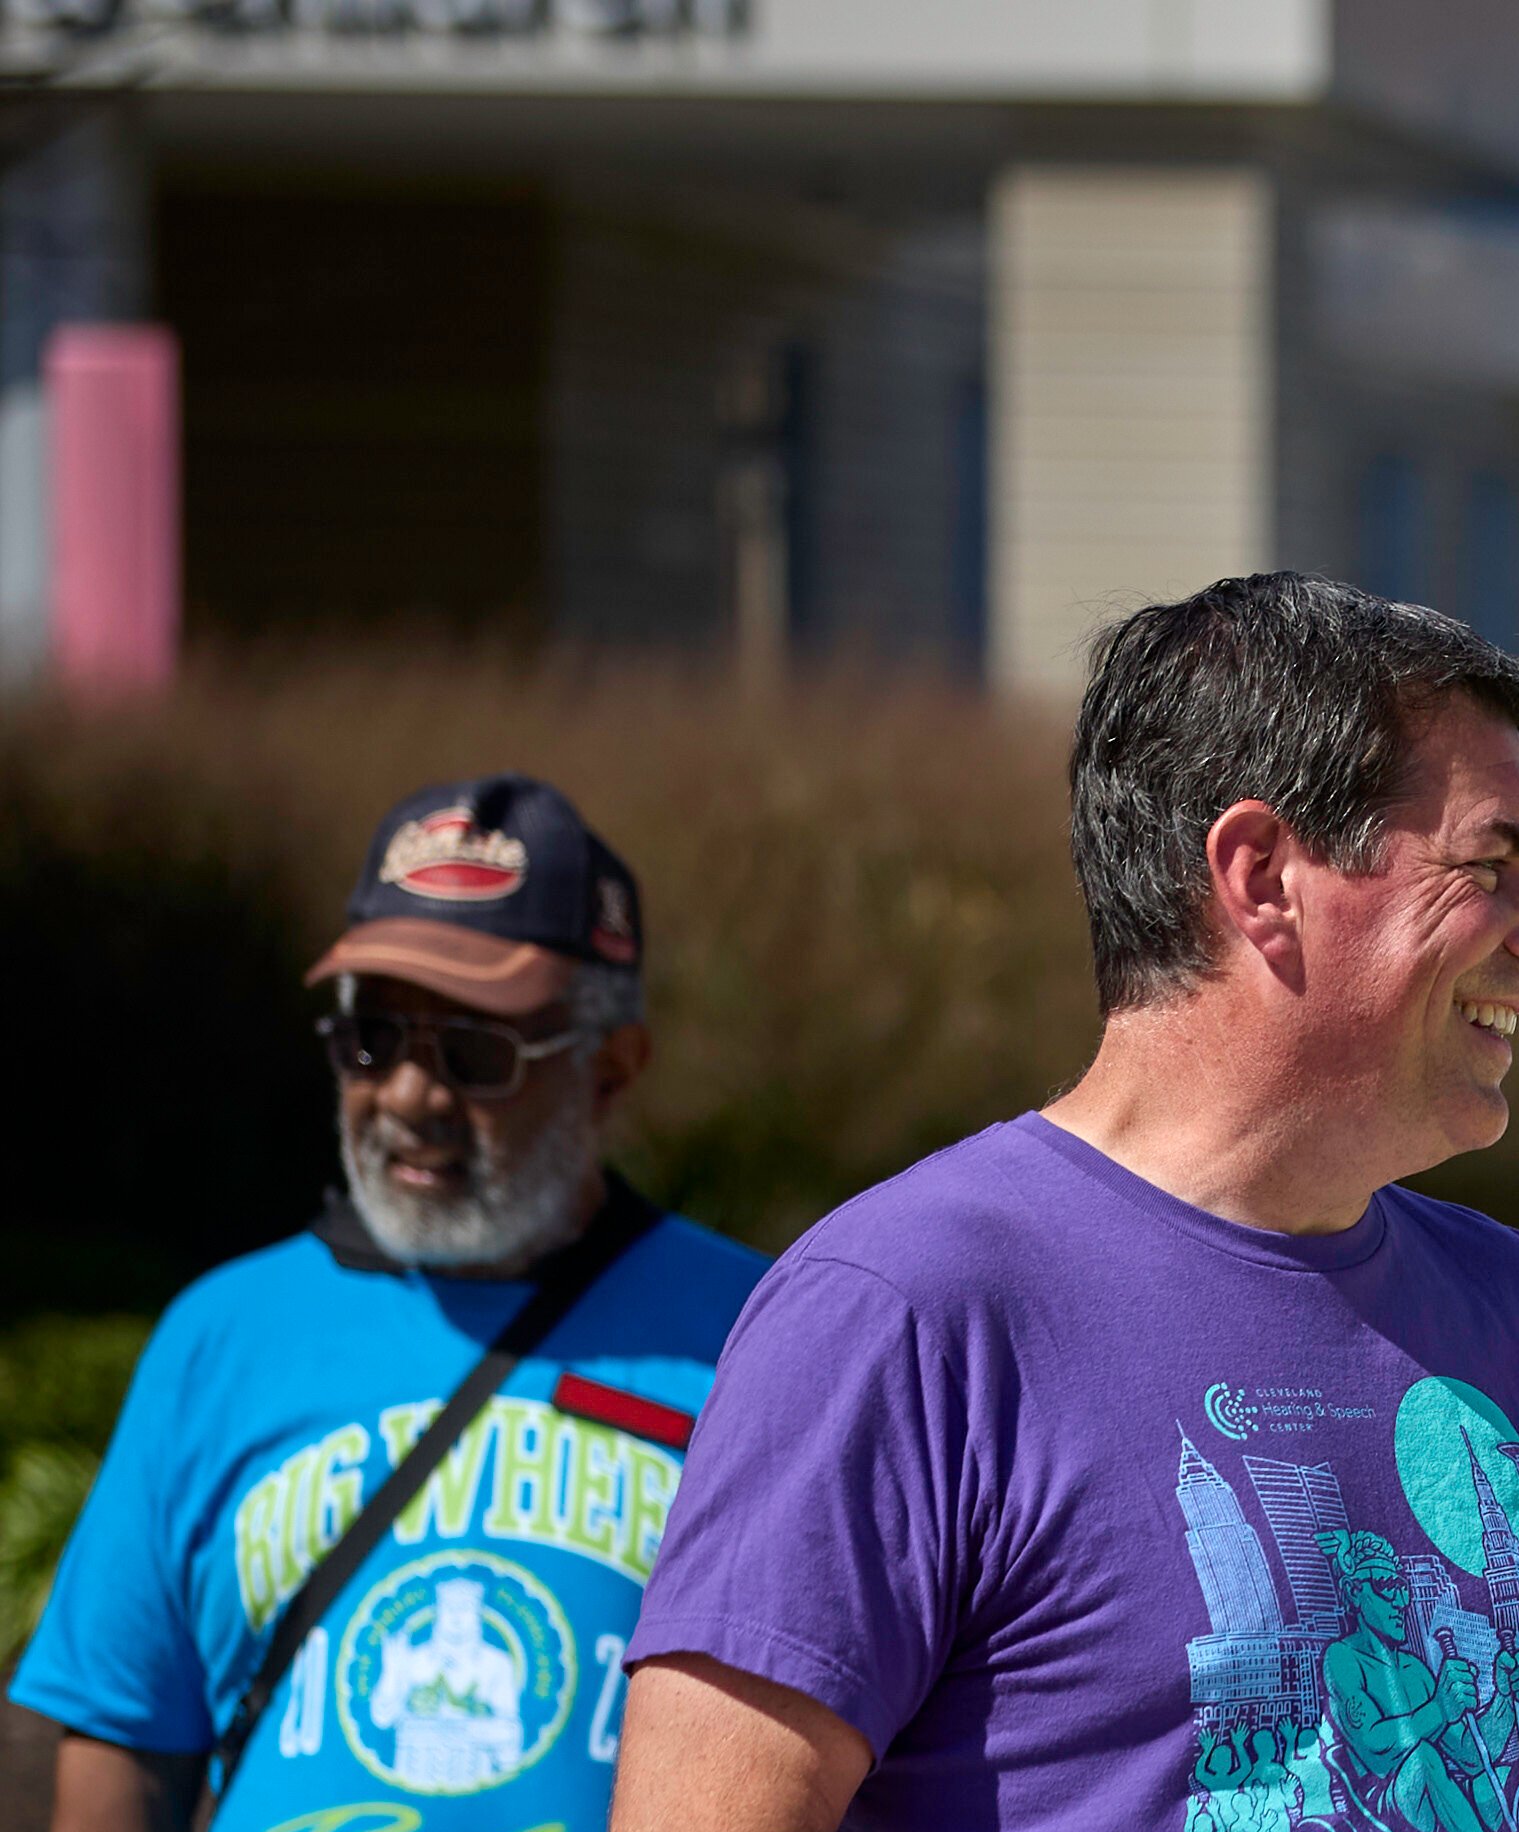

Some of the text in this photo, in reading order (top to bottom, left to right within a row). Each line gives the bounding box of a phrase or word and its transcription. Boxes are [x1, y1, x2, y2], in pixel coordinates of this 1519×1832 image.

[1255, 1388, 1323, 1399] CLEVELAND
[1262, 1401, 1377, 1421] Hearing & Speech
[1269, 1422, 1314, 1433] CENTER
